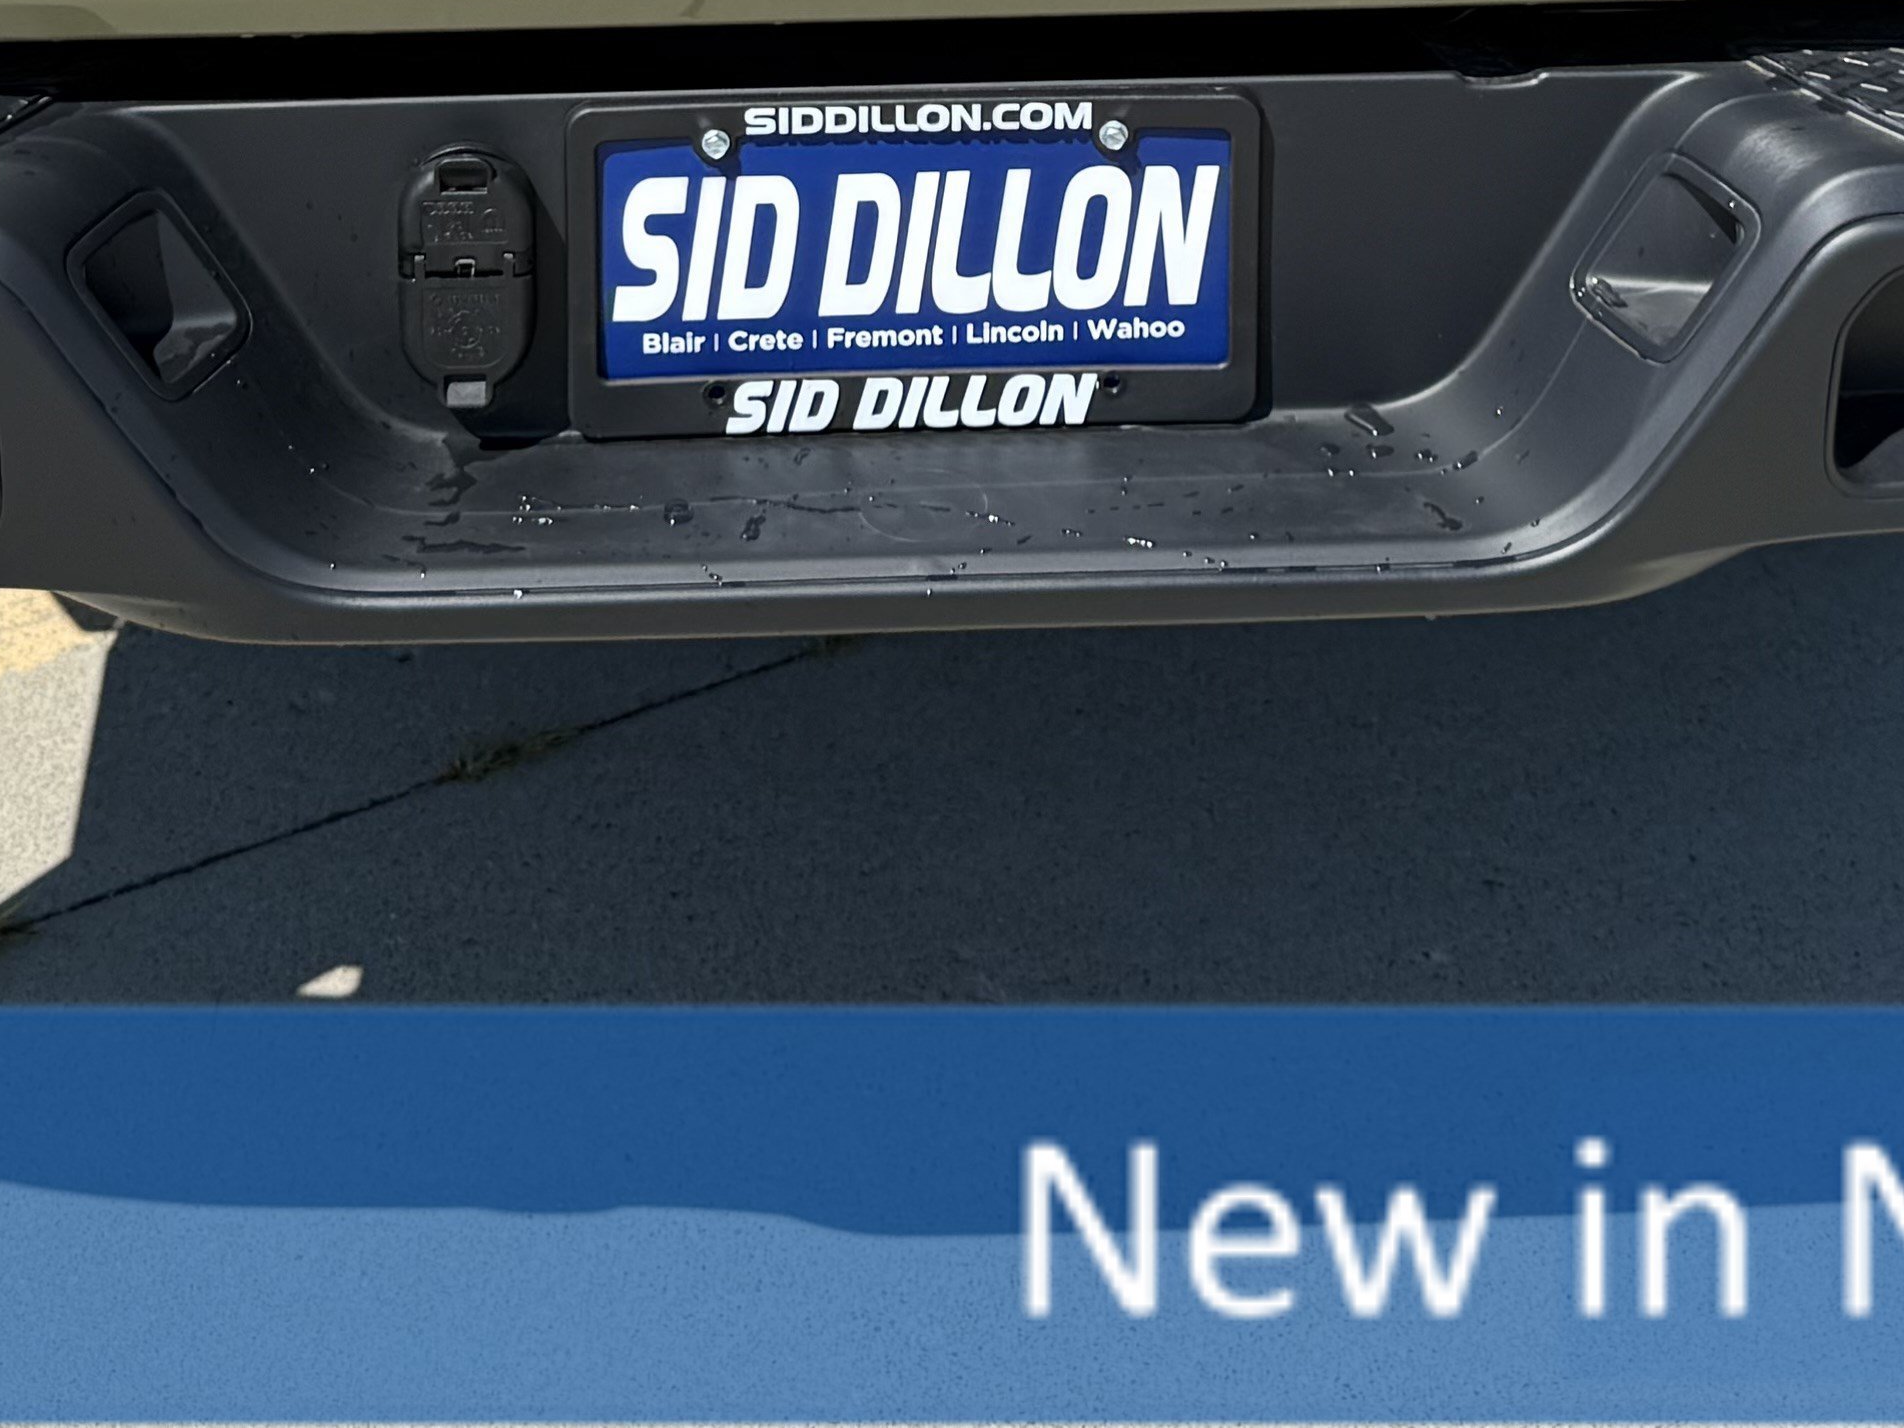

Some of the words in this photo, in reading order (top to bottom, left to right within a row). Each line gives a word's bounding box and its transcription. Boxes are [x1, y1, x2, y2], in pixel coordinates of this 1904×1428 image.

[743, 101, 1093, 136] SIDDILLON.COM
[612, 175, 800, 322] SID
[817, 164, 1220, 317] DILLON
[642, 330, 706, 355] Blair
[727, 329, 804, 352] Crete
[827, 325, 944, 349] Fremont
[966, 318, 1064, 345] Lincoln
[1086, 317, 1186, 341] Wahoo
[725, 378, 840, 434] SID
[852, 372, 1100, 431] DILLON
